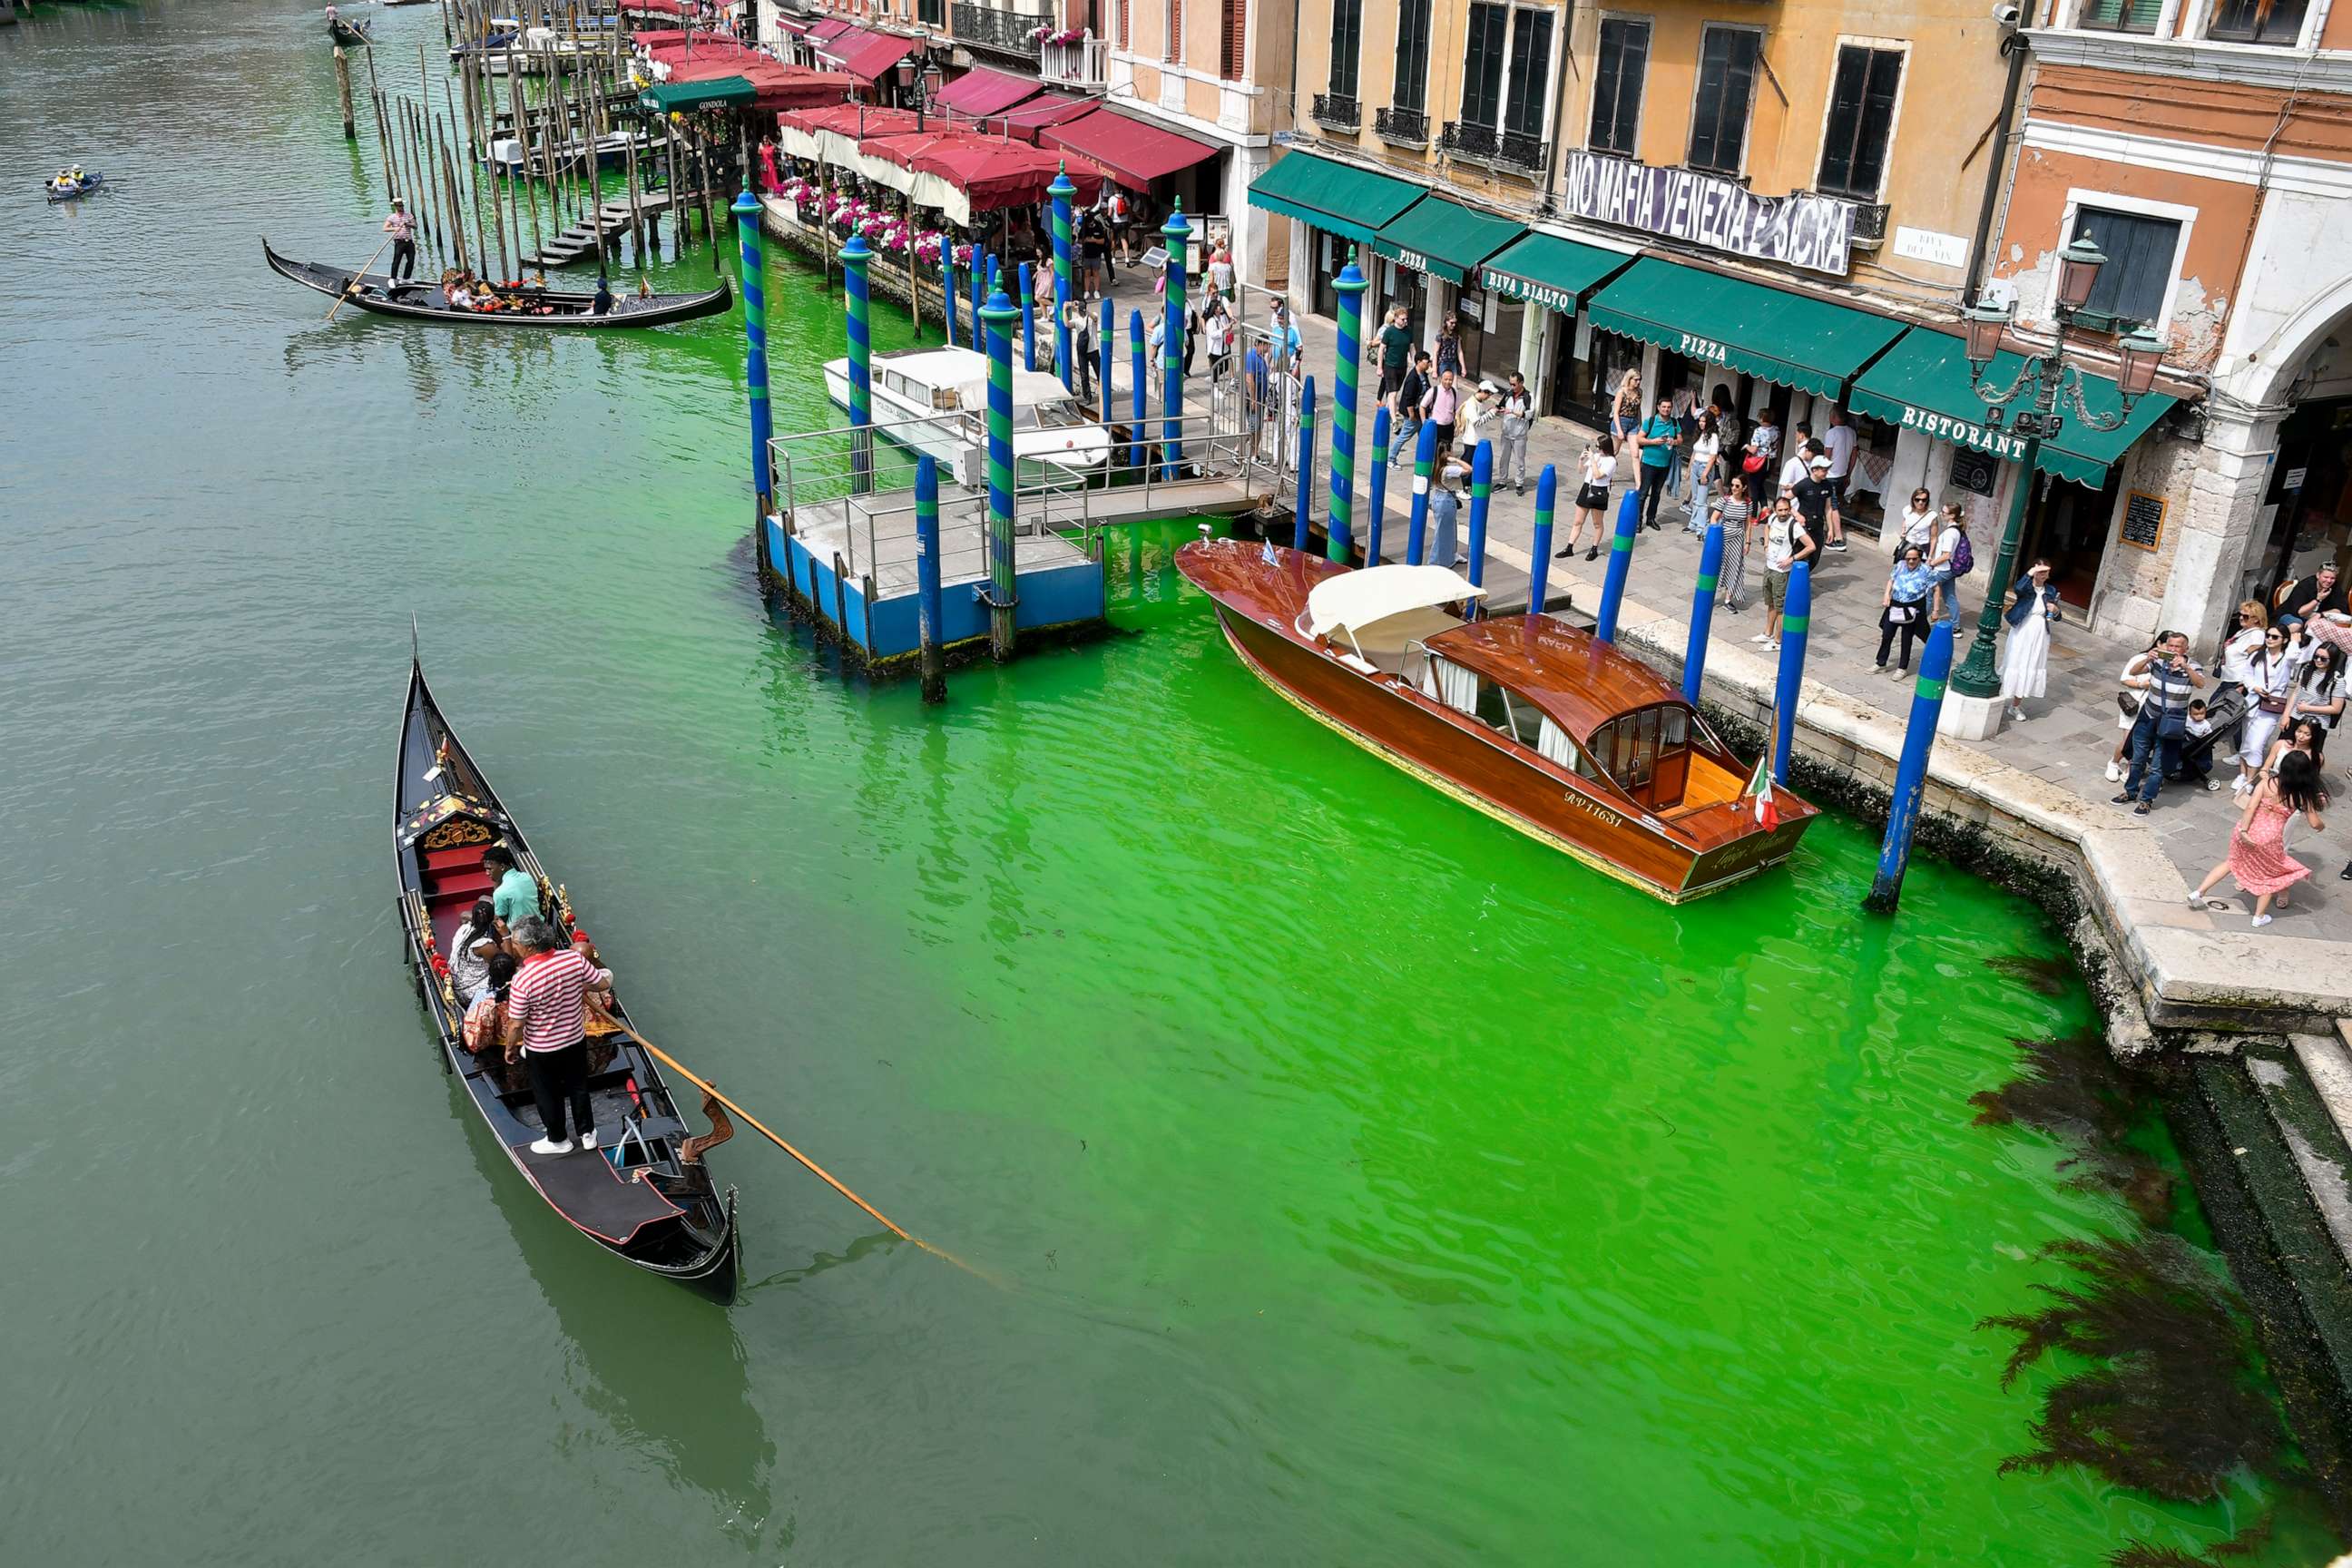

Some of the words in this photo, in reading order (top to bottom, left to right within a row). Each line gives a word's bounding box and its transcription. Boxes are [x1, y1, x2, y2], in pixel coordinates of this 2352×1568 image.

[698, 99, 727, 110] GONDOLA
[1566, 152, 1595, 214] NO
[1596, 157, 1655, 229] MAFIA
[1660, 170, 1749, 252] VENEZIA
[1774, 194, 1848, 272] SACRA
[1399, 249, 1426, 270] PIZZA
[1488, 272, 1516, 293] RIVA
[1522, 281, 1568, 309] RIALTO
[1680, 334, 1726, 361] PIZZA
[1902, 406, 2025, 458] RISTORANT
